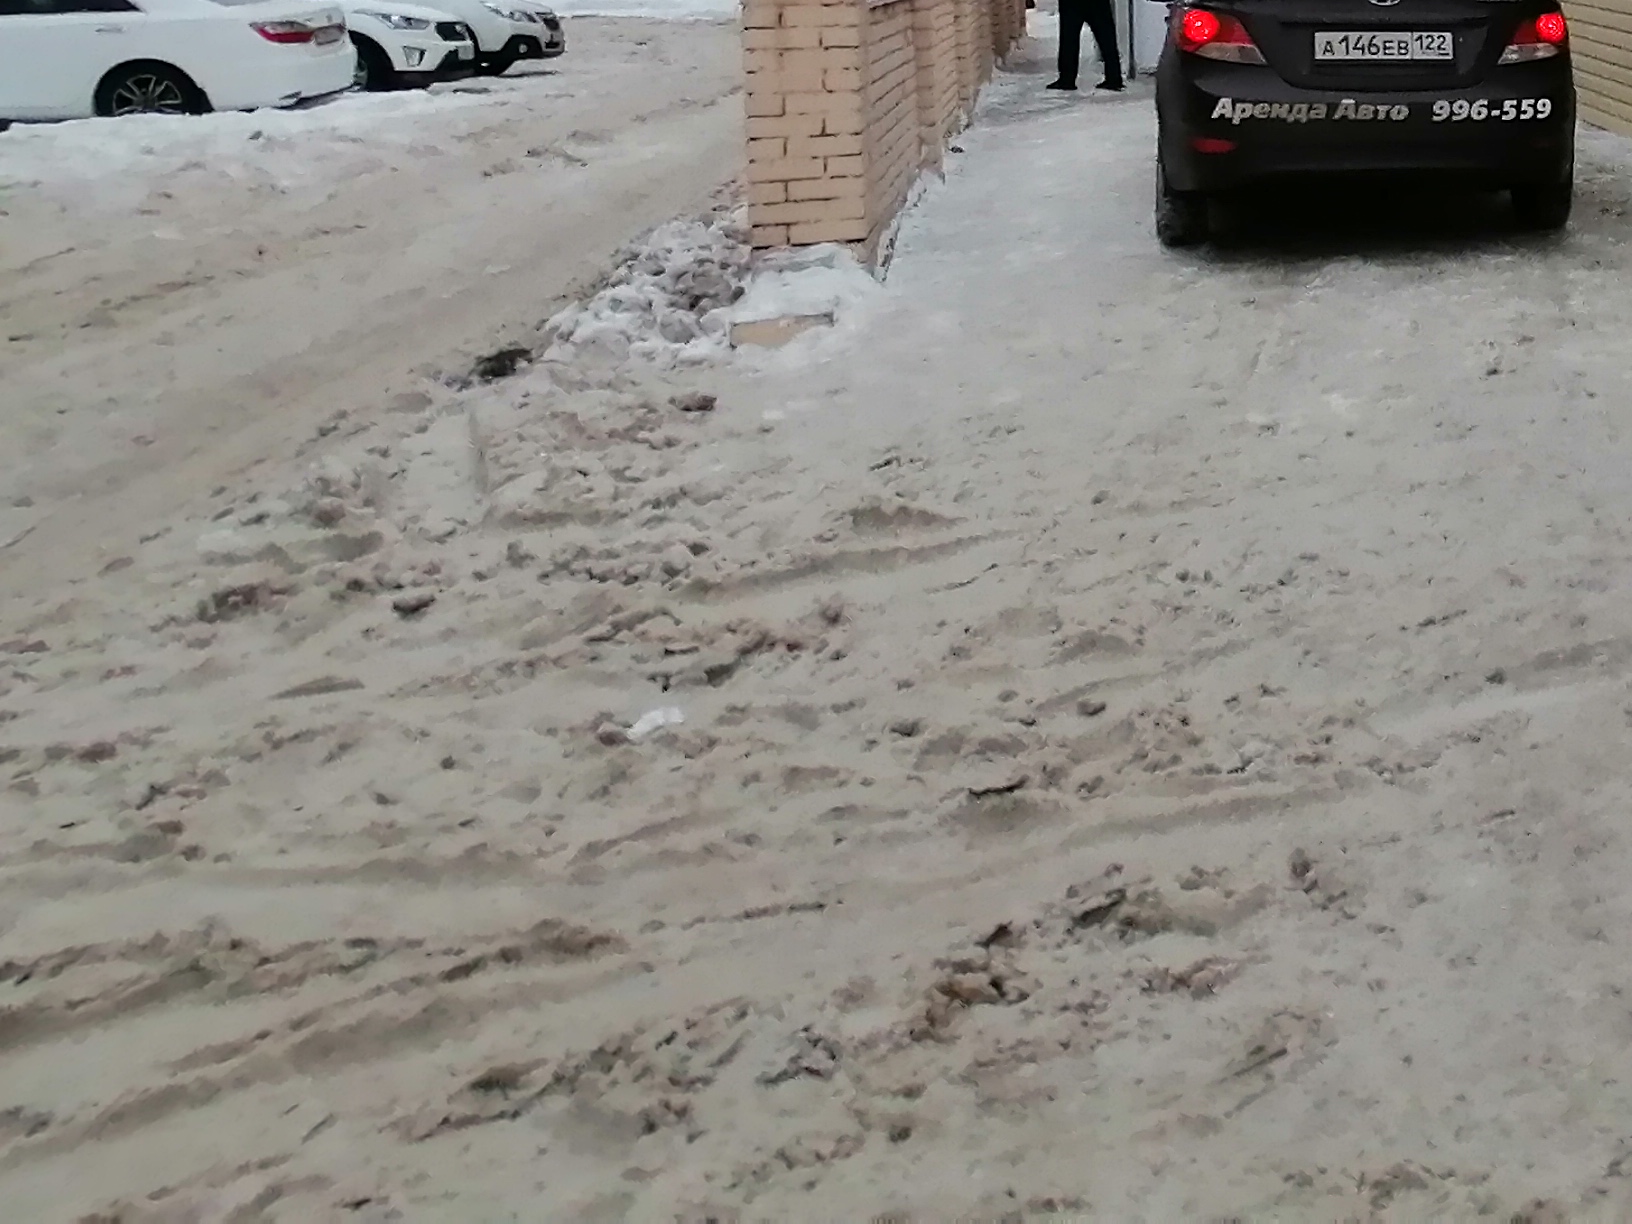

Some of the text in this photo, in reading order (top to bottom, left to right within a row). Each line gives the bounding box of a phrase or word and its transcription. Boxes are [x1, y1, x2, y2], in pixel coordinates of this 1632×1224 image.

[1211, 97, 1552, 125] Аренда Авто 996-559
